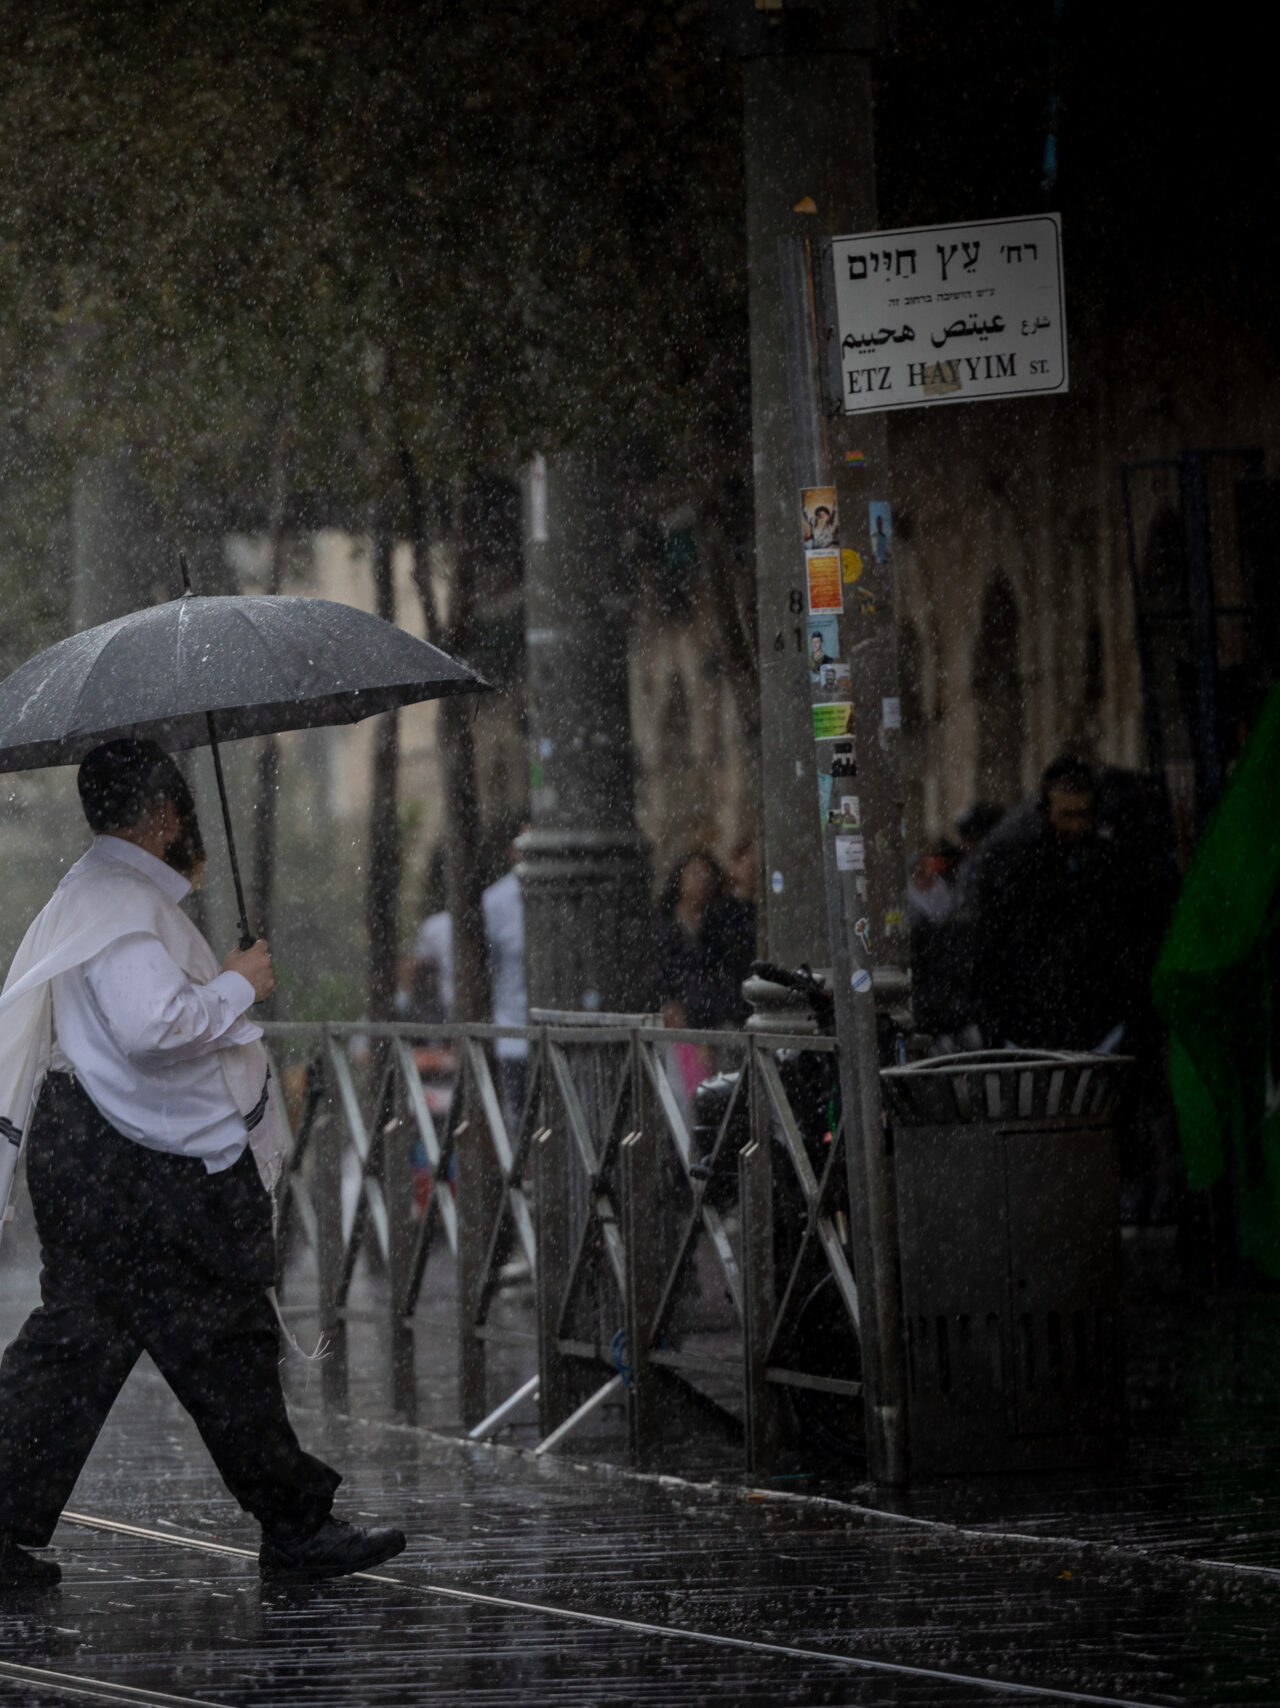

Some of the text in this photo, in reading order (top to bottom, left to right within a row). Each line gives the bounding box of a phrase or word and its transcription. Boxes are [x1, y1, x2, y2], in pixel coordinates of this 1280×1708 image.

[1021, 316, 1051, 336] شارع
[848, 353, 1050, 394] ETZ HAYYIM ST.
